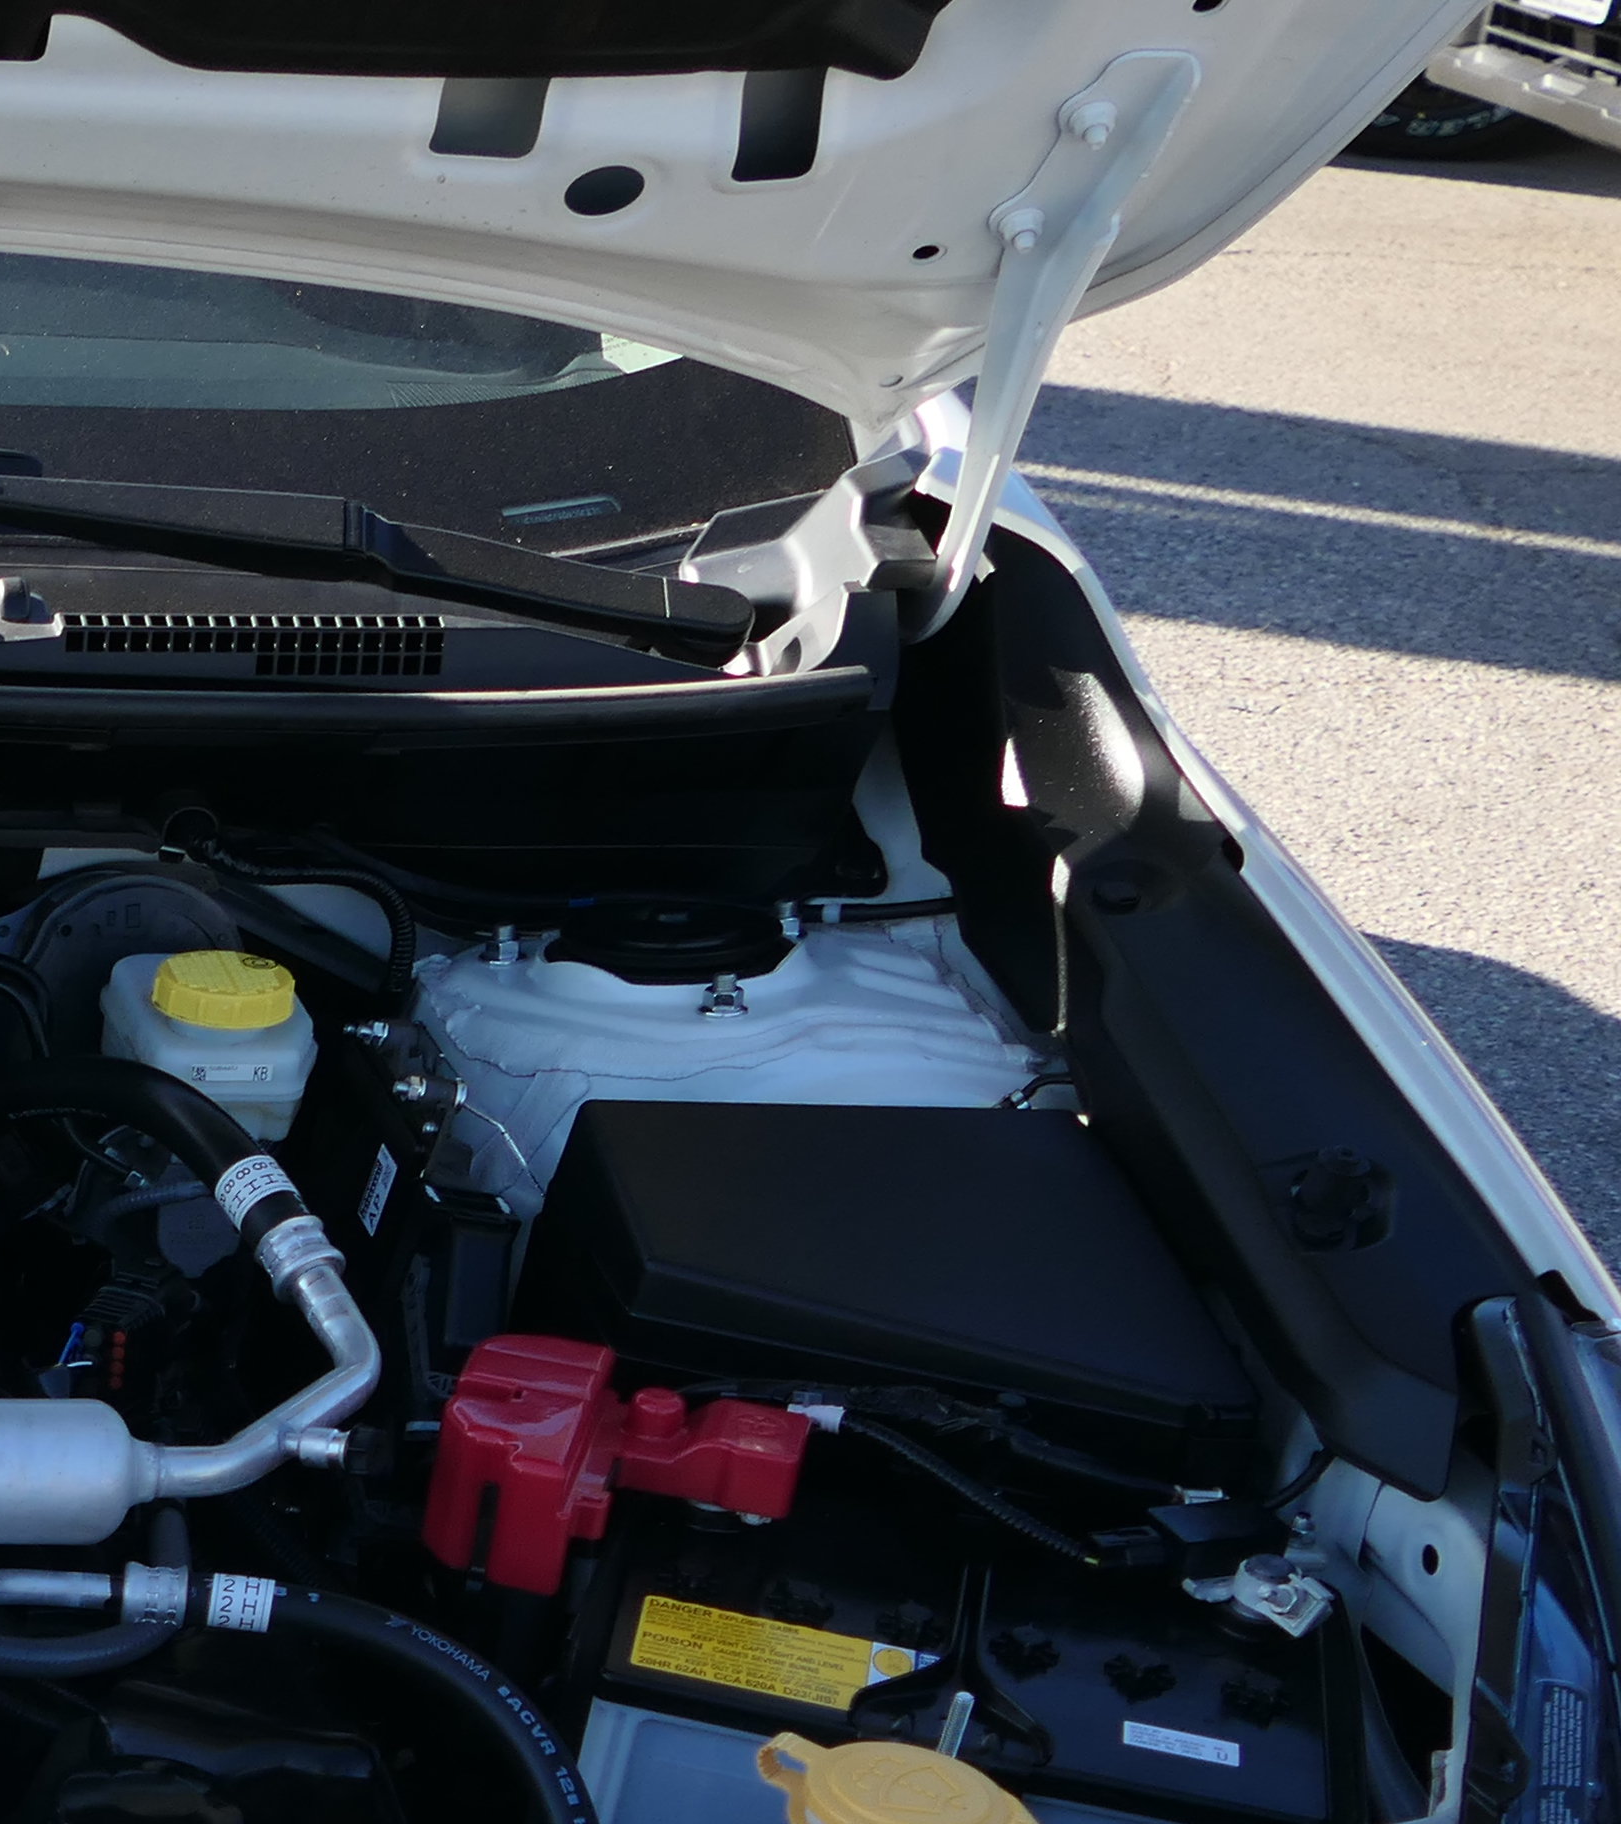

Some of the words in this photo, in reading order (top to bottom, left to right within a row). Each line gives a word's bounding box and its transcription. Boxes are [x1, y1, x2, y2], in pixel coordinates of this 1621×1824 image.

[252, 1066, 268, 1081] KB
[223, 1579, 235, 1592] 2
[244, 1581, 260, 1595] H
[220, 1595, 233, 1612] 2
[241, 1598, 257, 1615] H
[649, 1598, 712, 1618] DANGER
[642, 1630, 703, 1650] POISON
[716, 1638, 738, 1648] VENT
[411, 1624, 491, 1681] YOKOHAMA
[638, 1655, 671, 1668] 20HR
[674, 1663, 707, 1676] 62Ah
[713, 1671, 741, 1684] CCA
[745, 1678, 776, 1691] 620A
